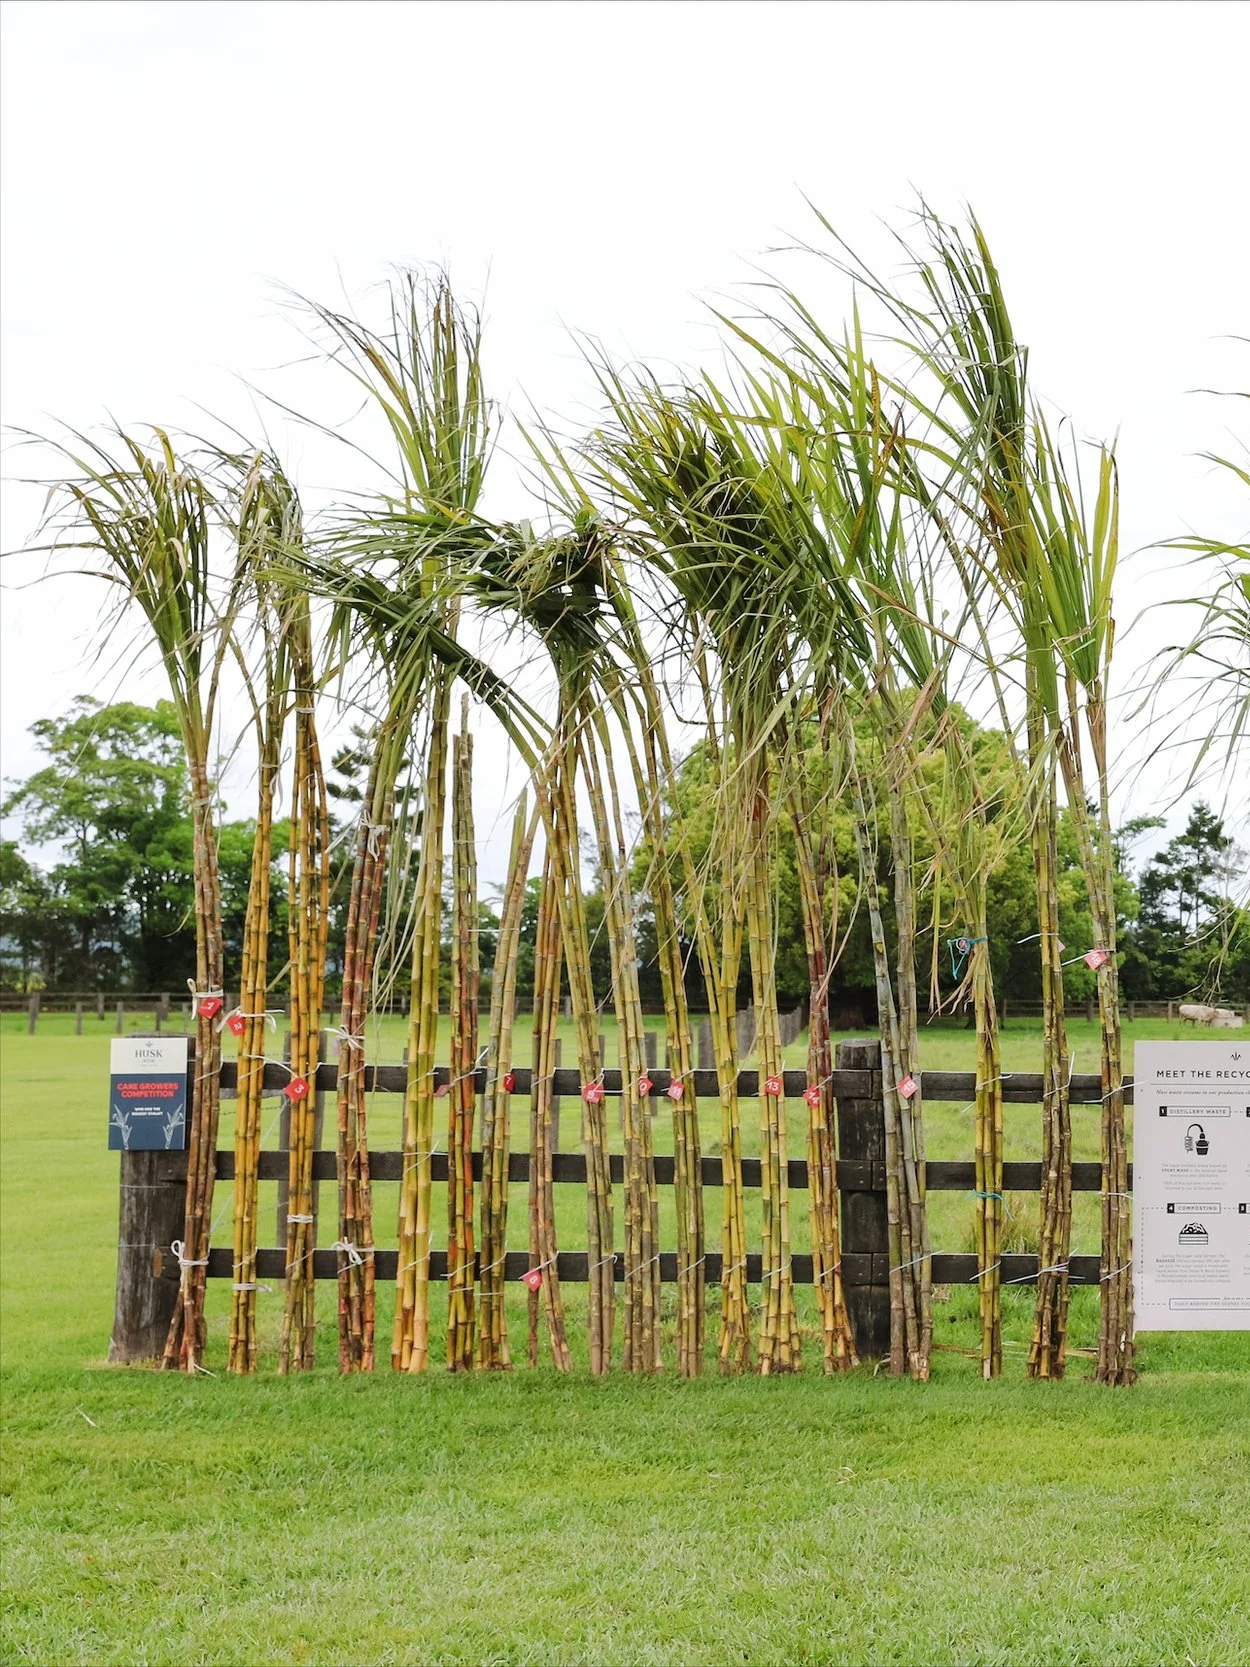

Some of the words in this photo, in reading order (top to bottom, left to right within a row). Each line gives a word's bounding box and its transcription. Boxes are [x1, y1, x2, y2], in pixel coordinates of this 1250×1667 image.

[1092, 953, 1102, 964] 18
[206, 1002, 215, 1010] 1
[234, 1022, 242, 1032] 2
[135, 1050, 162, 1058] HUSK
[294, 1084, 305, 1094] 3
[768, 1081, 780, 1091] 13
[904, 1080, 916, 1092] 15
[529, 1275, 538, 1284] 8
